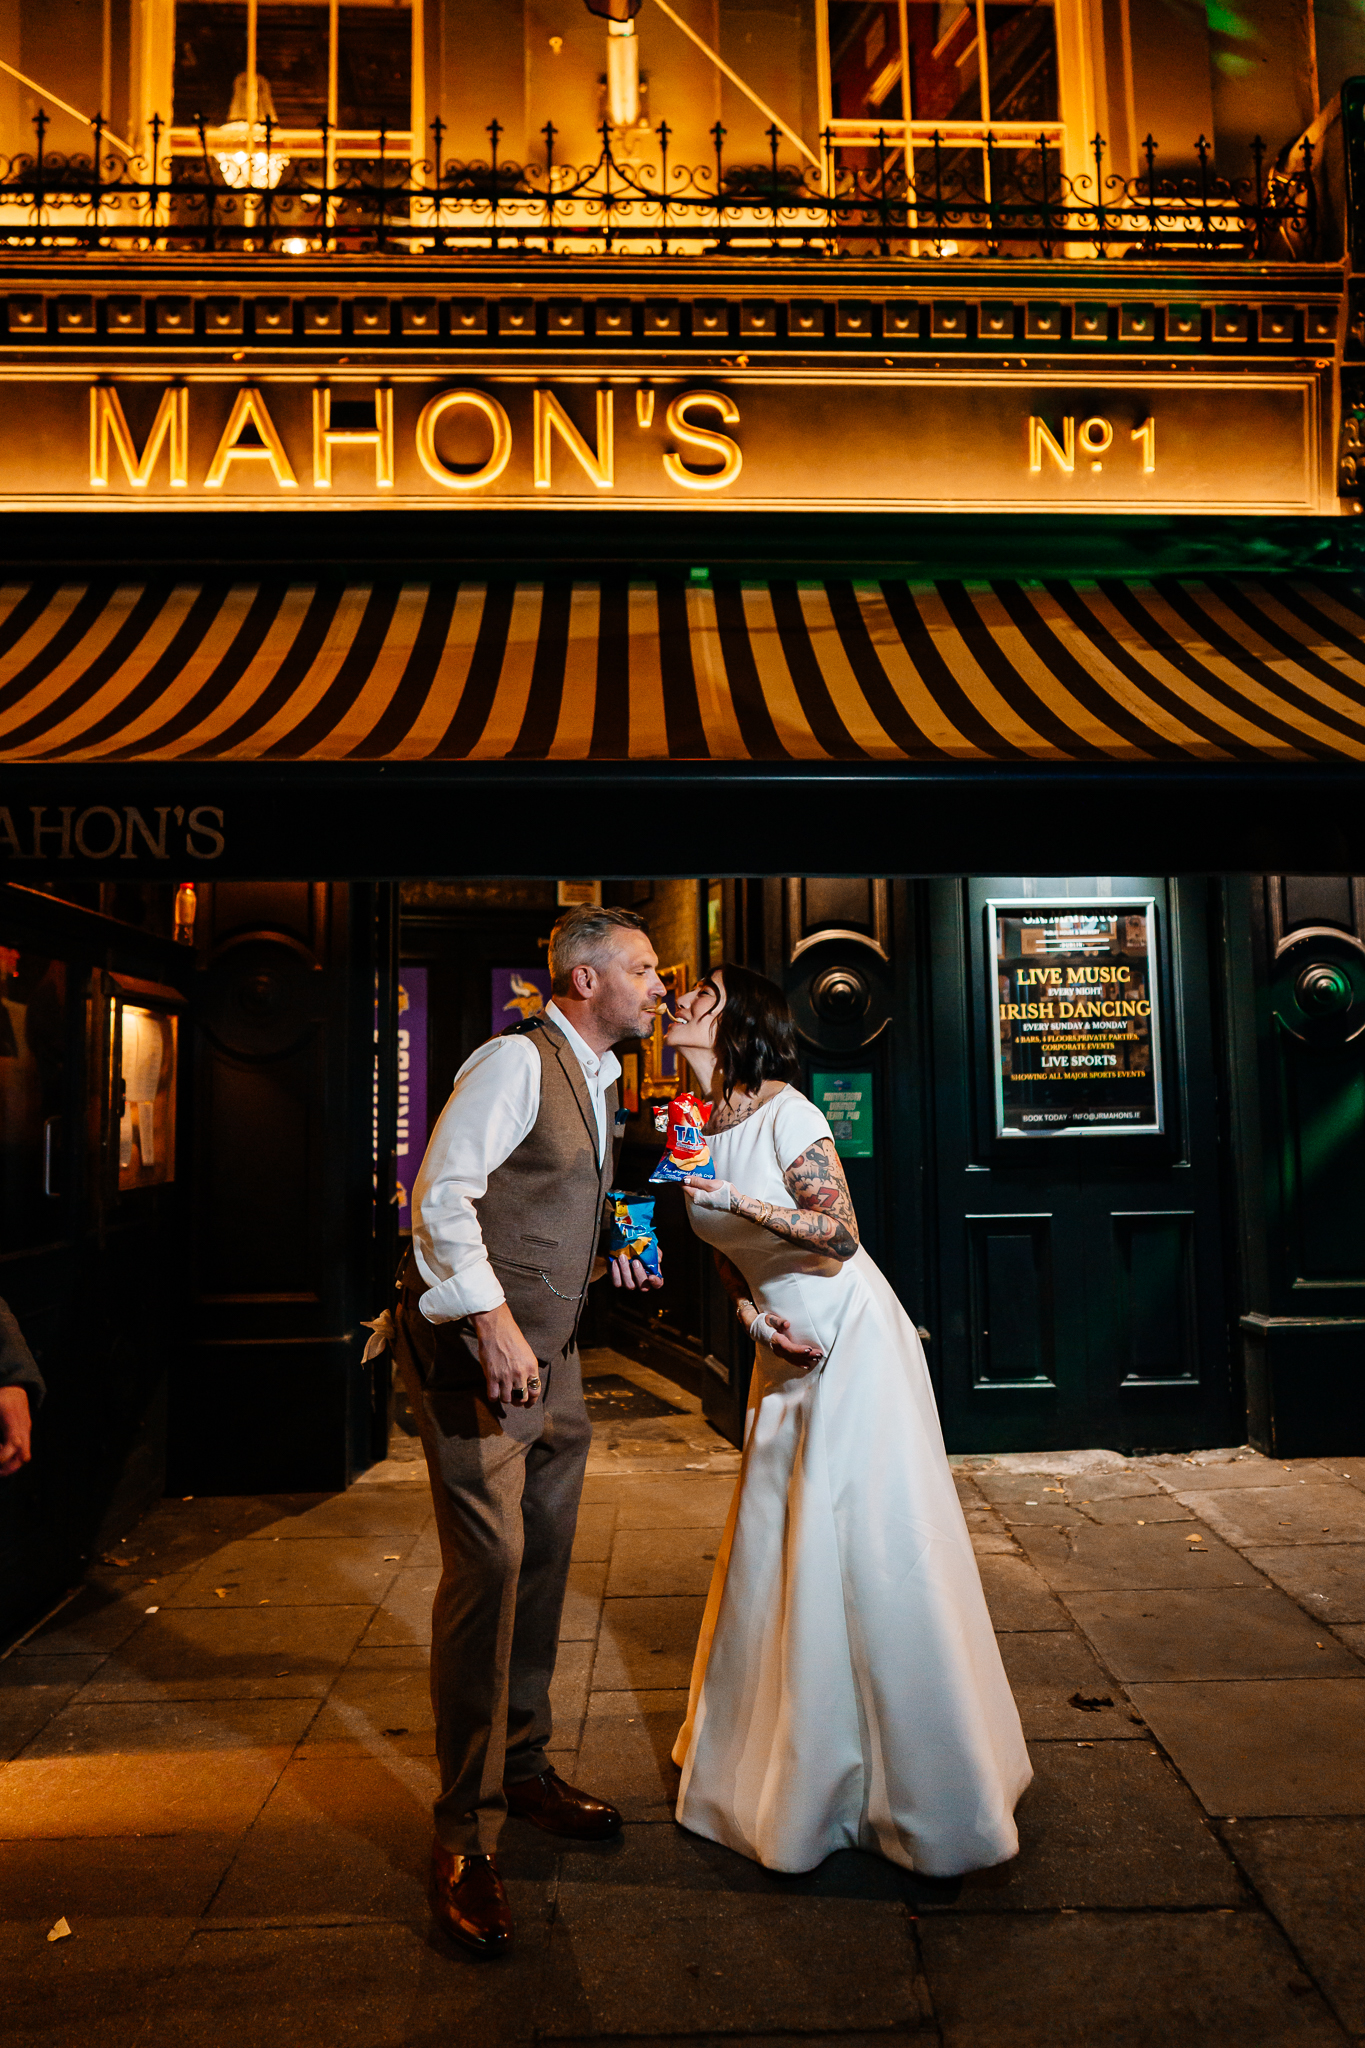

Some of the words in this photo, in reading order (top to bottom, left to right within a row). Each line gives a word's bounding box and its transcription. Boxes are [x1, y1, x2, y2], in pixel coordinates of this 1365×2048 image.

[90, 385, 744, 490] MAHON'S
[1131, 416, 1155, 473] 1
[1017, 968, 1063, 985] LIVE
[1067, 966, 1131, 984] MUSIC
[1048, 988, 1074, 996] EVERY
[1075, 986, 1102, 996] NIGHT
[1000, 1002, 1054, 1020] IRISH
[1059, 1000, 1151, 1018] DANCING
[1023, 1023, 1049, 1031] EVERY
[1051, 1022, 1083, 1031] SUNDAY
[1084, 1022, 1091, 1030] &
[1092, 1021, 1127, 1030] MONDAY
[1041, 1043, 1087, 1051] CORPORATE
[1087, 1042, 1115, 1050] EVENTS
[1041, 1056, 1069, 1067] LIVE
[1071, 1055, 1117, 1066] SPORTS
[1011, 1073, 1047, 1081] SHOWING
[1049, 1072, 1062, 1080] ALL
[1064, 1072, 1088, 1080] MAJOR
[1089, 1071, 1116, 1079] SPORTS
[1118, 1070, 1145, 1078] EVENTS
[1023, 1114, 1043, 1122] BOOK
